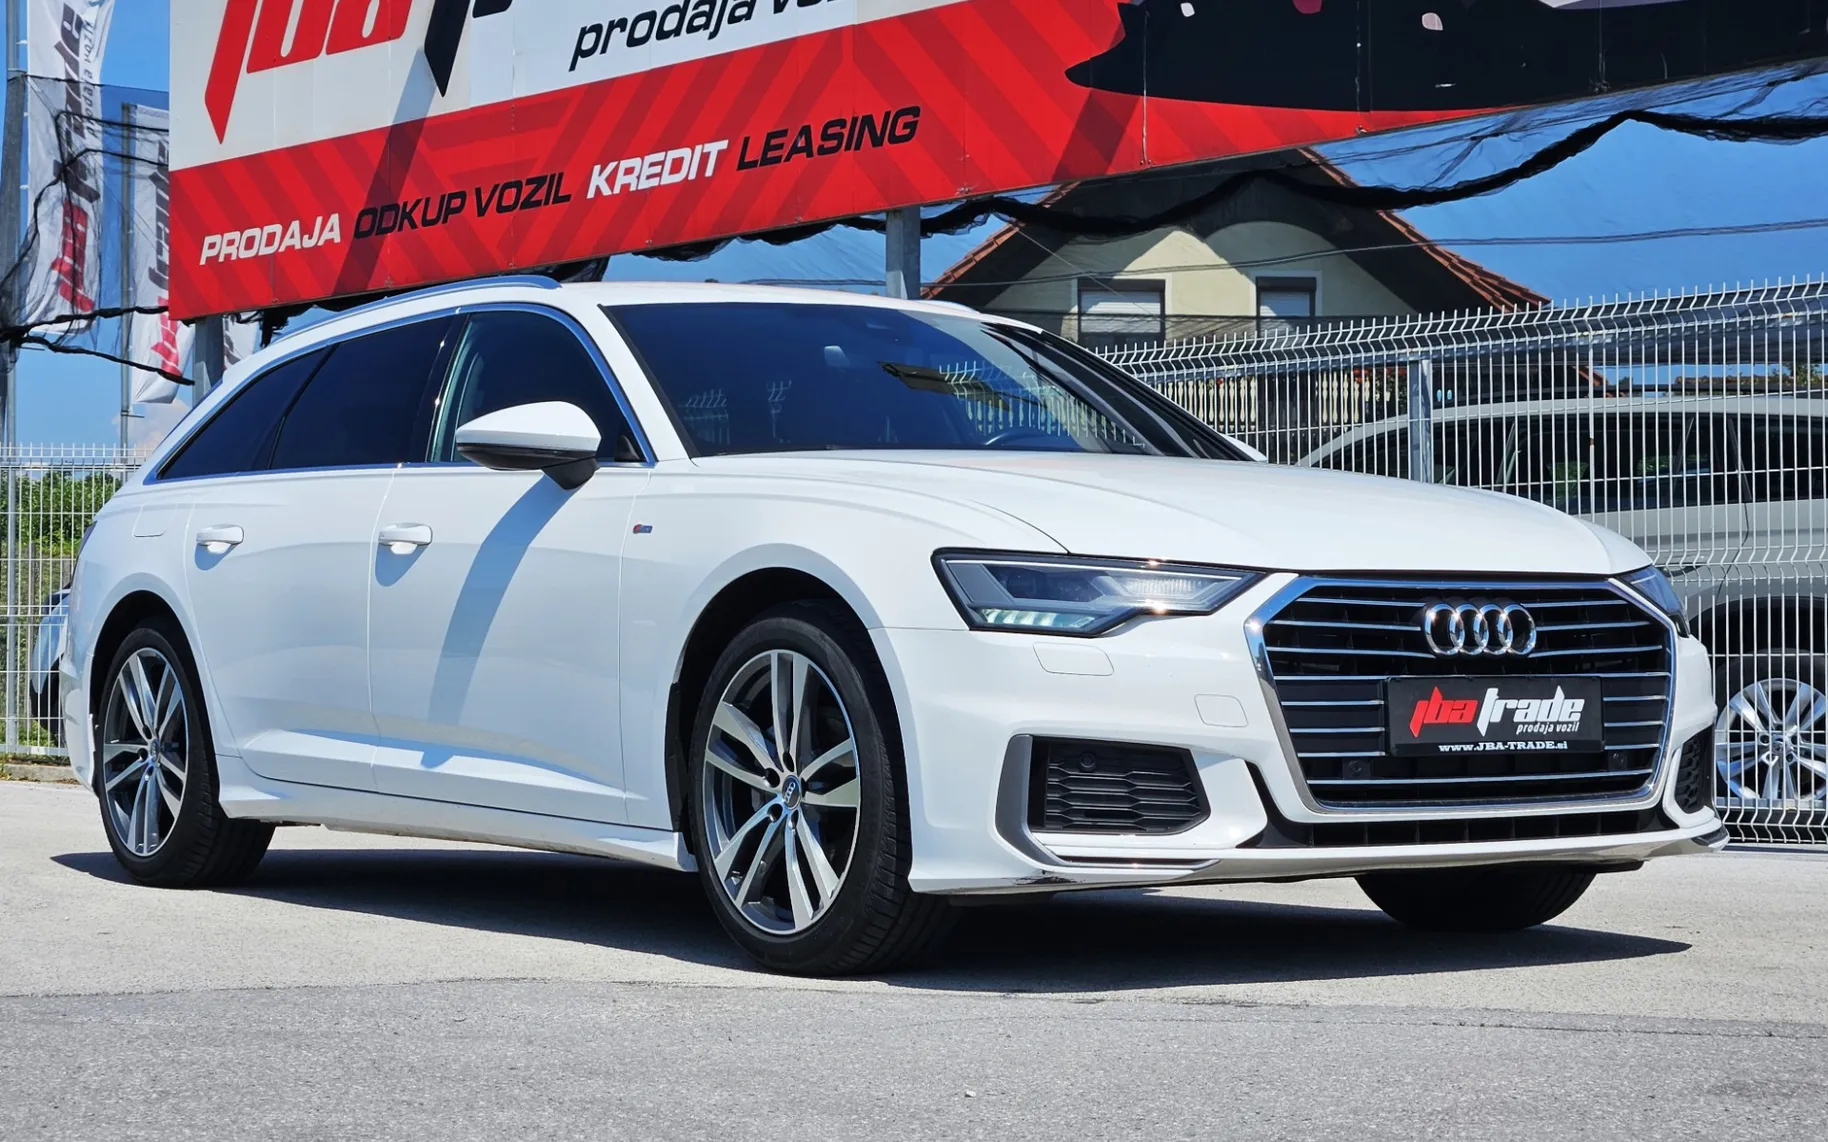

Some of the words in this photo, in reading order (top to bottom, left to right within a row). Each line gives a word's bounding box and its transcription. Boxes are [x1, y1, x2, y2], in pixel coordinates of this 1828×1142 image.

[199, 213, 341, 266] PRODAJA
[353, 190, 468, 240] ODKUP
[474, 171, 572, 218] VOZIL
[586, 139, 729, 200] KREDIT
[736, 106, 921, 171] LEASING
[1516, 722, 1554, 735] prodaja
[1556, 721, 1580, 733] vozil
[1438, 740, 1568, 752] www.JBA-TRADE.si
